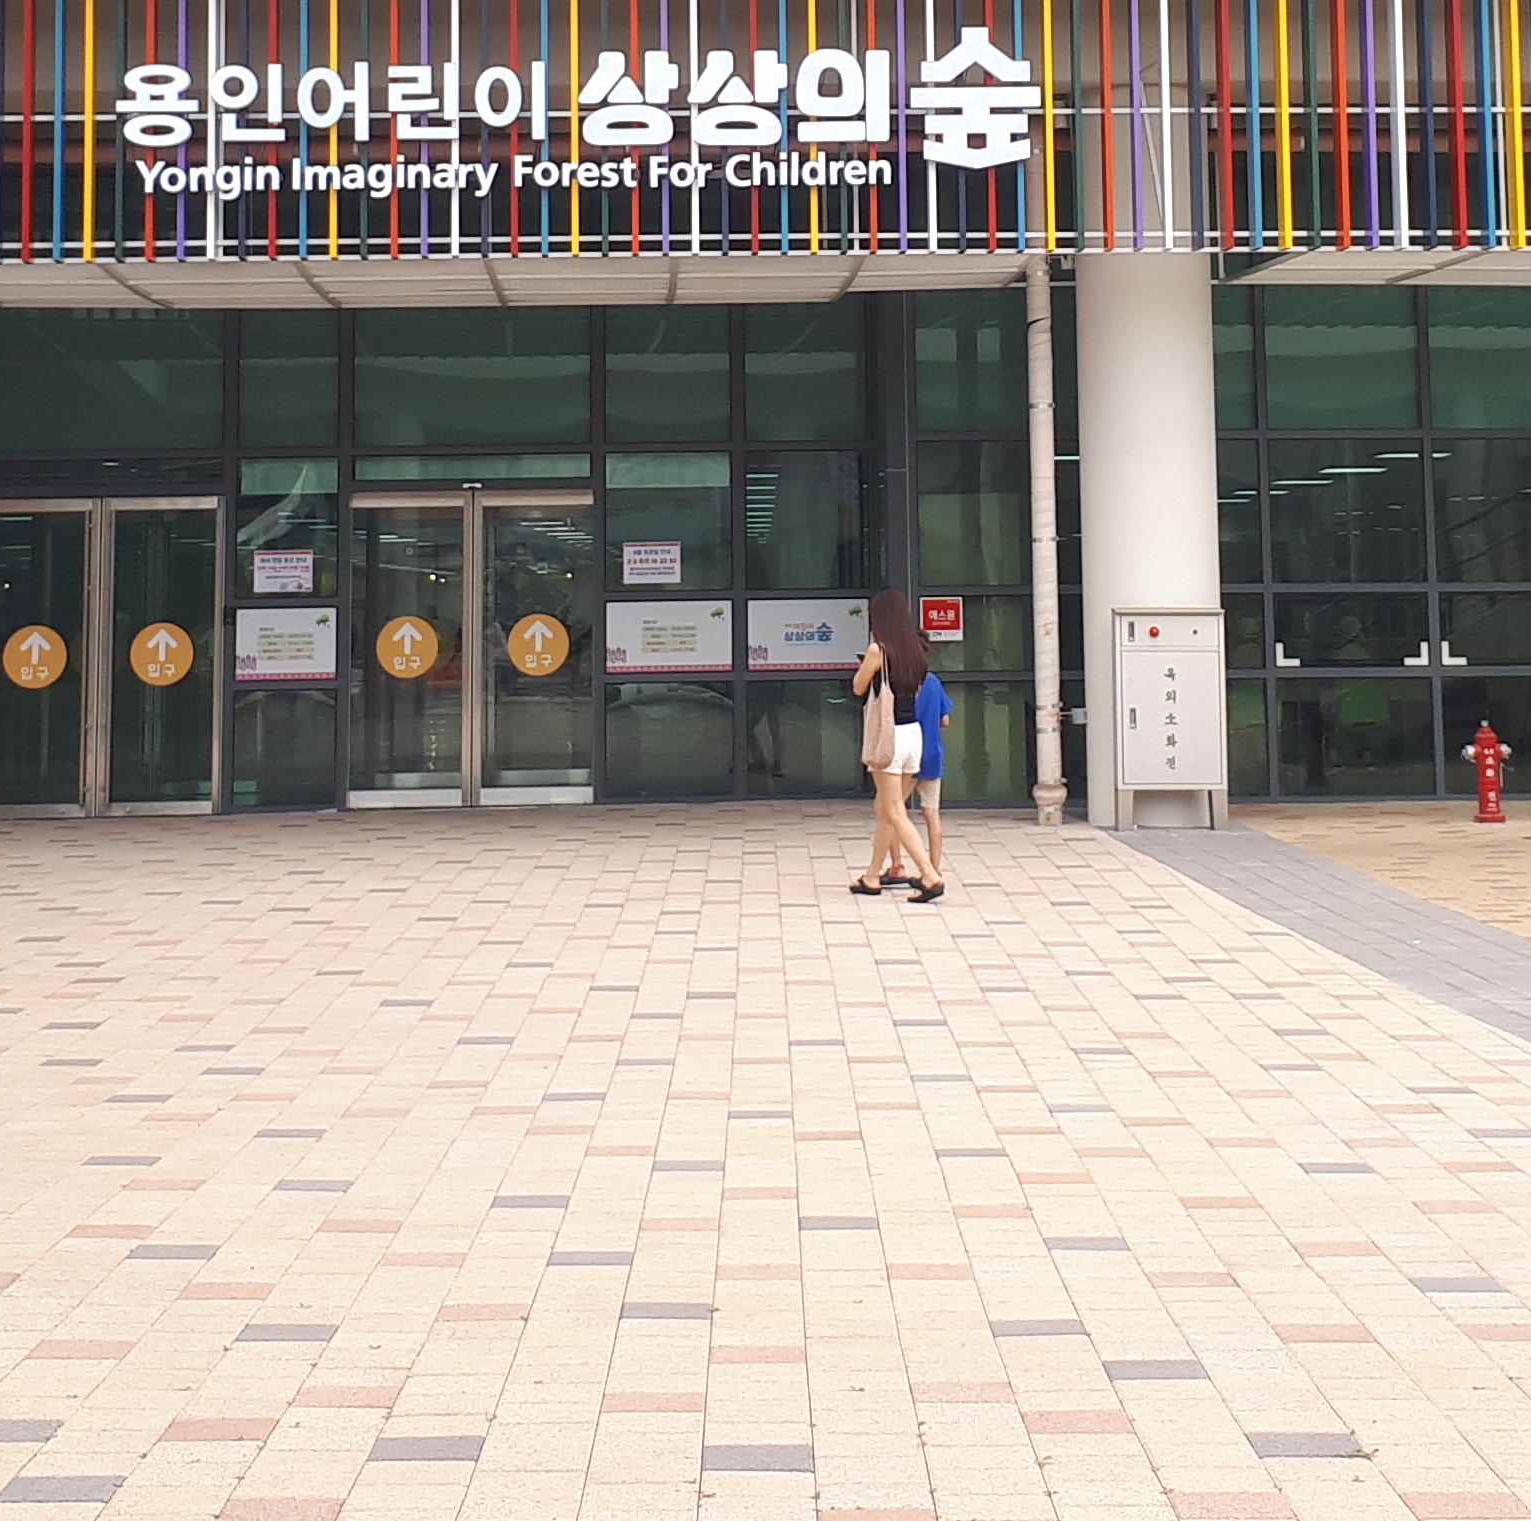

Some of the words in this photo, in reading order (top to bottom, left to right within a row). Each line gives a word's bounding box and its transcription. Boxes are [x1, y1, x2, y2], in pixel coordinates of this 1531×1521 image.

[115, 60, 546, 147] 용인어린이
[134, 156, 284, 202] Yongin
[292, 155, 499, 199] Imaginary
[512, 154, 638, 189] Forest
[649, 153, 712, 188] For
[737, 151, 893, 188] Children
[393, 655, 422, 671] 입구
[524, 653, 553, 669] 입구
[20, 665, 50, 680] 입구
[147, 663, 177, 678] 입구
